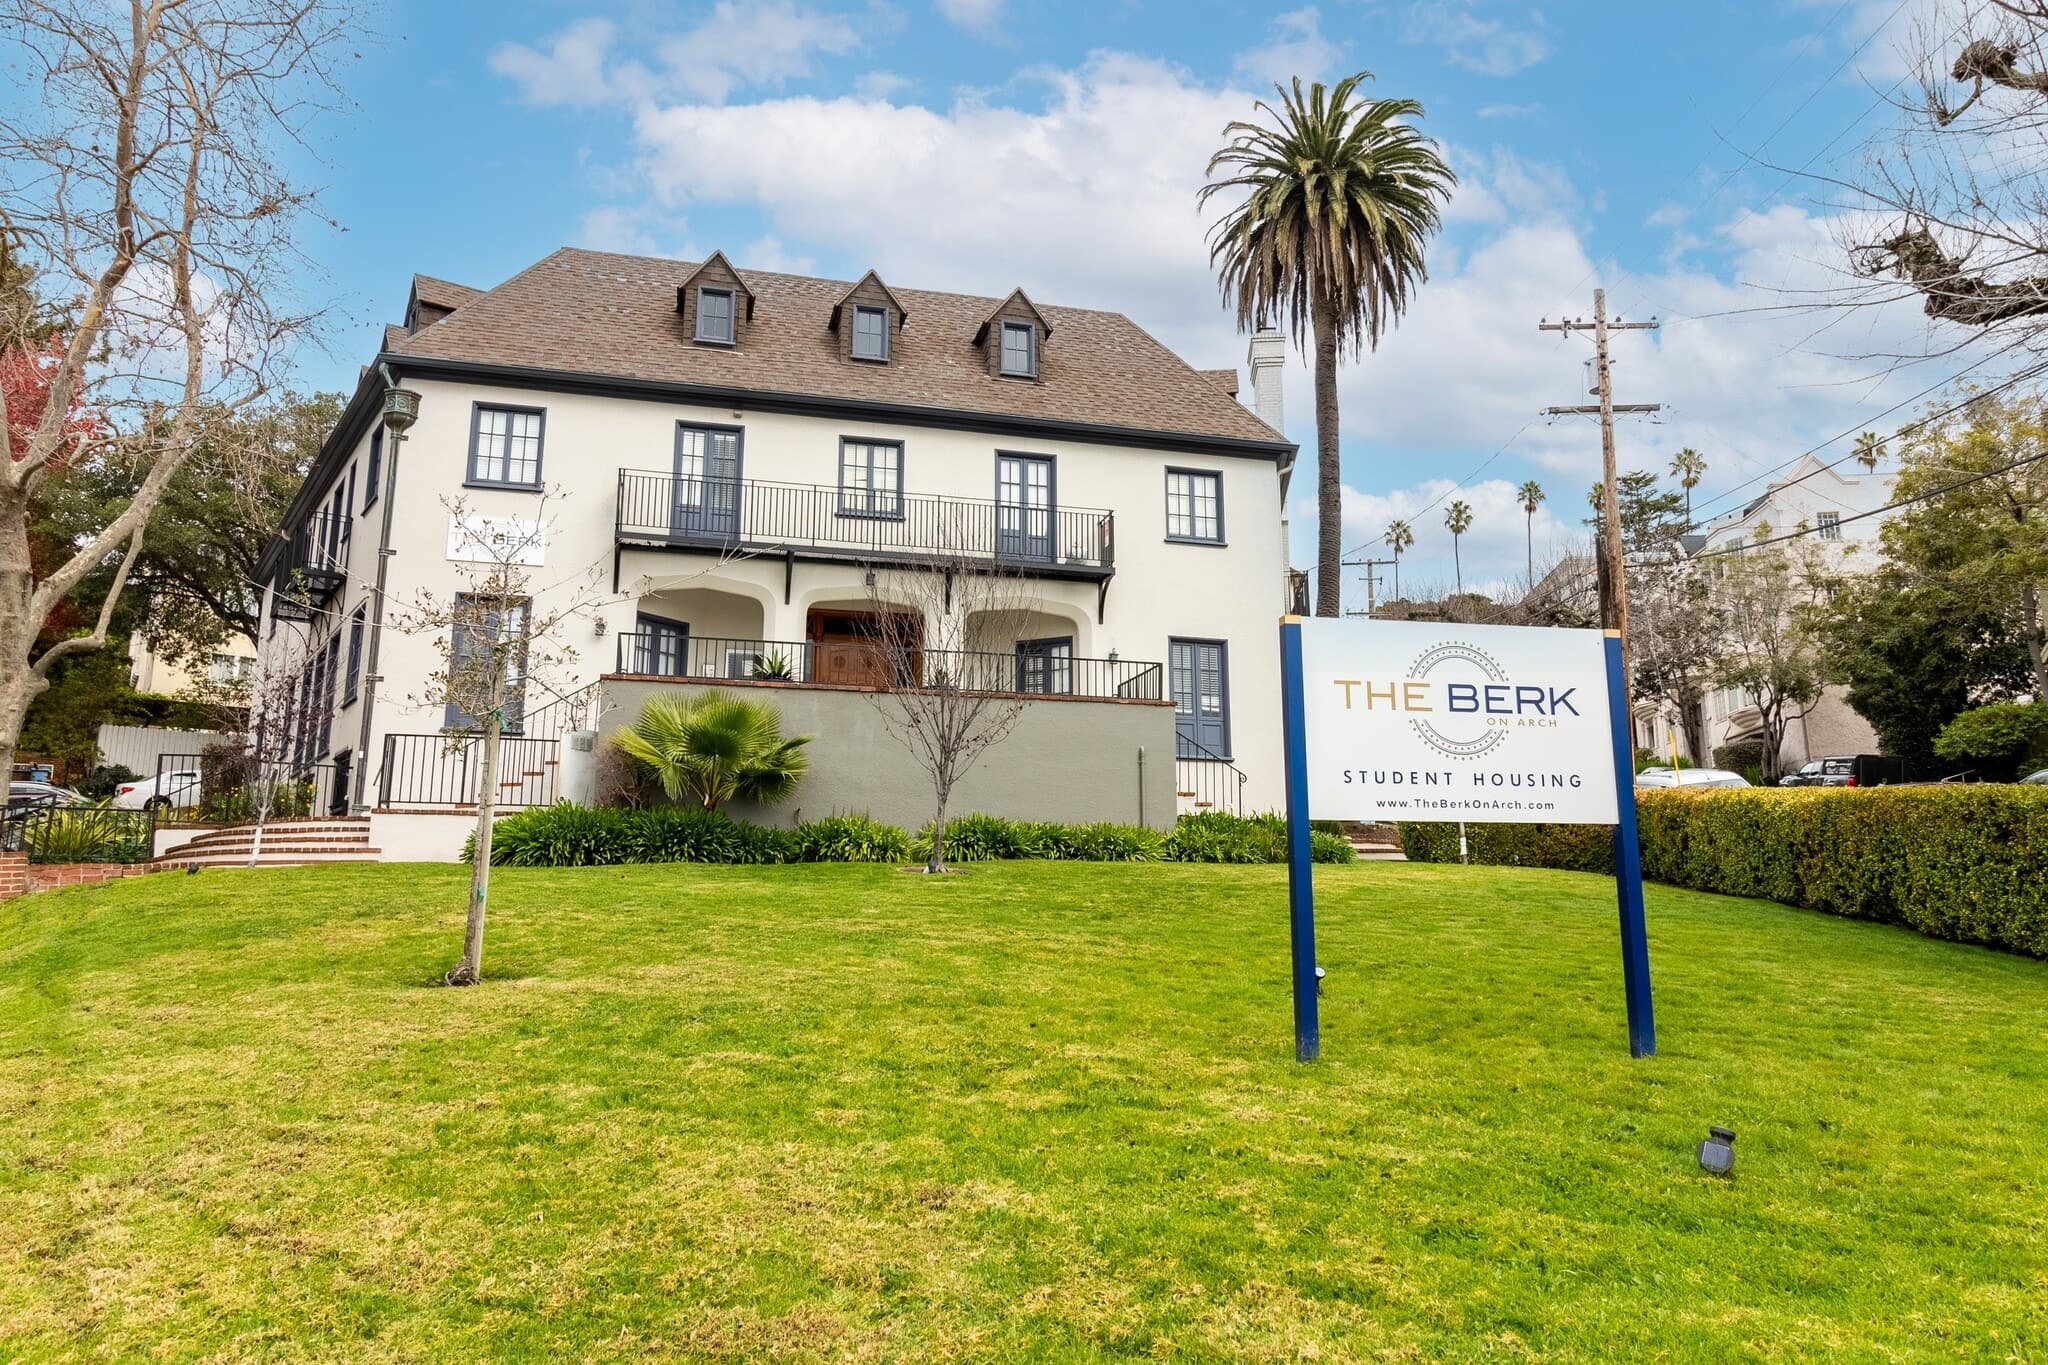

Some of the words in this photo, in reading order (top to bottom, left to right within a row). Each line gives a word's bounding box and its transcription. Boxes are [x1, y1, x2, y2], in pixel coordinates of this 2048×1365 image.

[1333, 680, 1433, 713] THE
[1448, 683, 1580, 716] BERK
[1486, 717, 1509, 727] ON
[1517, 718, 1558, 728] ARCH
[1343, 770, 1453, 786] STUDENT
[1473, 773, 1583, 788] HOUSING
[1376, 798, 1555, 811] www.TheBerkOnArch.com
